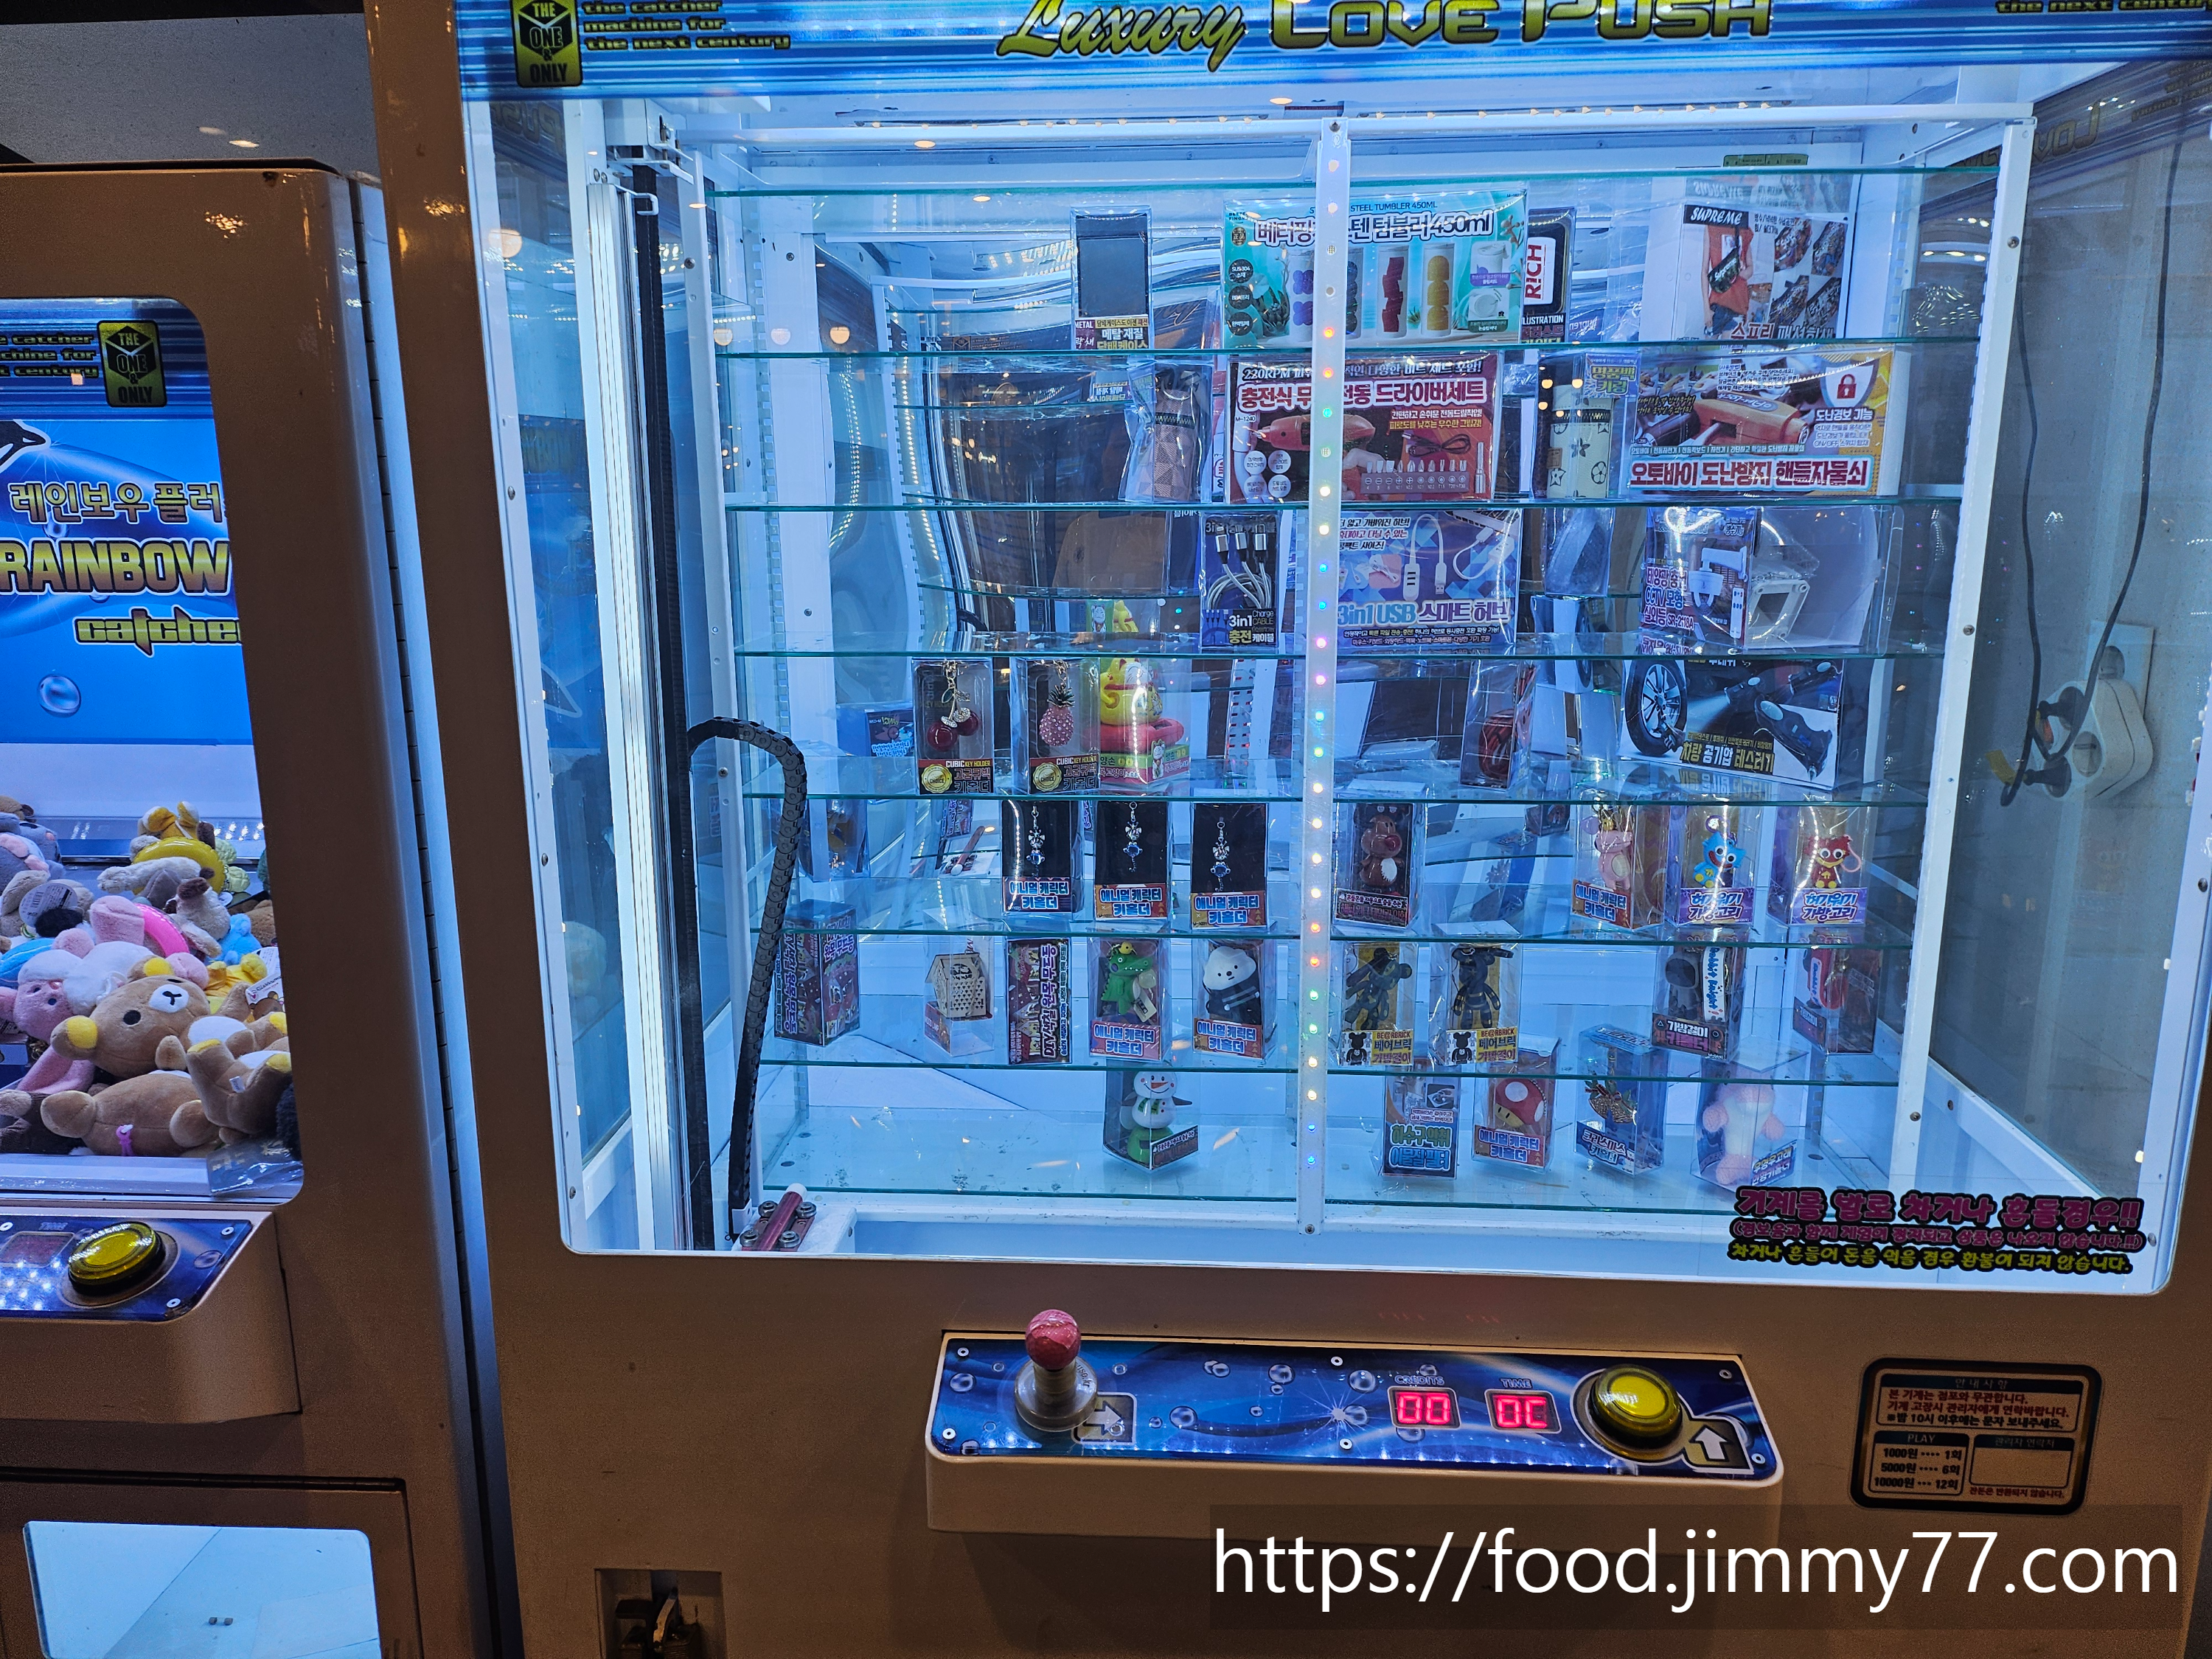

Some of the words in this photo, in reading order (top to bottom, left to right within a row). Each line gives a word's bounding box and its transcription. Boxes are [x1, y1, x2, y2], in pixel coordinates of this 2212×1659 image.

[533, 1, 556, 18] THE
[583, 17, 683, 33] machine
[686, 15, 726, 31] for
[529, 27, 563, 49] ONE
[585, 36, 628, 50] the
[632, 35, 692, 49] next
[695, 34, 790, 50] century
[997, 0, 1247, 72] Luxury
[1270, 0, 1499, 49] LOVE
[543, 47, 552, 60] &
[530, 63, 567, 83] ONLY
[1374, 203, 1410, 211] TUMBLER
[1691, 208, 1742, 224] SUPREME
[1258, 220, 1316, 244] 베터핑
[1525, 244, 1543, 299] RICH
[1074, 321, 1093, 329] METAL
[12, 333, 94, 345] catcher
[118, 333, 140, 346] THE
[0, 348, 58, 361] chine
[60, 349, 96, 361] for
[116, 354, 147, 373] ONE
[15, 366, 99, 378] century
[129, 373, 139, 384] &
[1591, 365, 1636, 380] 명품백
[117, 386, 153, 404] ONLY
[1596, 380, 1627, 394] 키링
[1242, 386, 1292, 408] 충전식
[1815, 408, 1851, 421] 도난경보
[1854, 408, 1873, 420] 기능
[1630, 462, 1698, 487] 오토바이
[1702, 461, 1772, 487] 도난방지
[1775, 460, 1868, 487] 핸들자물쇠
[10, 483, 150, 524] 레인보우
[1384, 529, 1391, 538] 수
[1392, 529, 1408, 538] 있는
[1360, 541, 1385, 550] 사이즈!
[0, 540, 229, 594] RAINBOW
[1647, 567, 1669, 587] 태양광
[1645, 585, 1666, 604] CCTV
[1666, 589, 1684, 609] 모형
[1229, 615, 1252, 627] 3in1
[1253, 610, 1273, 618] Charge
[1338, 603, 1373, 625] 3in1
[1377, 603, 1416, 624] USB
[1419, 602, 1471, 623] 스마트
[1474, 601, 1509, 622] 허브
[74, 607, 242, 656] catche
[1229, 630, 1252, 644] 충전
[1252, 633, 1274, 643] 케이블
[1100, 757, 1116, 766] 양손
[1680, 742, 1703, 762] 차량
[1703, 744, 1733, 767] 공기압
[1009, 881, 1038, 894] 애니멀
[1038, 880, 1068, 896] 캐릭터
[1100, 888, 1130, 903] 애니멀
[1131, 887, 1162, 902] 캐릭터
[1022, 895, 1058, 910] 키홀더
[1195, 895, 1225, 911] 애니멀
[1227, 894, 1259, 909] 캐릭터
[1575, 883, 1600, 903] 애니멀
[1600, 890, 1627, 910] 캐릭터
[1113, 902, 1150, 917] 키홀더
[1208, 909, 1248, 925] 키홀더
[1584, 900, 1615, 922] 키홀더
[1041, 944, 1057, 979] 무드등
[1093, 1025, 1123, 1040] 애니멀
[1124, 1027, 1155, 1044] 캐릭터
[1196, 1023, 1226, 1038] 애니멀
[1226, 1025, 1258, 1042] 캐릭터
[1377, 1031, 1411, 1040] BE@RBRICK
[1481, 1028, 1514, 1037] BE@RBRICK
[1667, 1020, 1708, 1038] 가방걸이
[1106, 1040, 1144, 1057] 키홀더
[1208, 1037, 1245, 1054] 키홀더
[1374, 1040, 1411, 1051] 베어브릭
[1479, 1037, 1516, 1049] 베어브릭
[1374, 1052, 1411, 1065] 가방걸이
[1478, 1049, 1516, 1062] 가방걸이
[1391, 1124, 1427, 1146] 하수구
[1478, 1128, 1507, 1146] 애니멀
[1508, 1133, 1540, 1152] 캐릭터
[1391, 1147, 1425, 1168] 이물질
[1489, 1144, 1528, 1163] 키홀더
[1738, 1189, 1825, 1221] 기계를
[1833, 1192, 1893, 1221] 발로
[1902, 1193, 1994, 1223] 차거나
[1805, 1223, 1838, 1240] 함께
[1840, 1225, 1888, 1242] 게임이
[1892, 1227, 1952, 1244] 정지되고
[1956, 1230, 2004, 1247] 상품은
[2007, 1231, 2056, 1248] 나오지
[1732, 1242, 1782, 1259] 차거나
[1787, 1245, 1838, 1262] 흔들어
[1843, 1247, 1877, 1264] 돈을
[1882, 1248, 1916, 1265] 먹을
[1923, 1251, 1955, 1266] 경우
[2017, 1253, 2051, 1269] 되지
[1394, 1375, 1445, 1386] CREDITS
[1500, 1378, 1533, 1388] TIME
[1888, 1389, 1900, 1399] 본
[1903, 1389, 1934, 1401] 기계는
[1938, 1391, 1970, 1402] 점포와
[1398, 1393, 1450, 1425] 00
[1888, 1401, 1908, 1412] 기계
[1911, 1402, 1943, 1413] 고장시
[1946, 1402, 2000, 1415] 관리자에게
[1911, 1413, 1935, 1425] 10시
[1938, 1413, 1980, 1426] 이후에는
[1982, 1415, 2004, 1427] 문자
[1907, 1433, 1935, 1444] PLAY
[1883, 1447, 1918, 1459] 1000원
[1944, 1450, 1962, 1461] 1회
[1881, 1462, 1916, 1474] 5000원
[1941, 1464, 1961, 1476] 6회
[1874, 1476, 1914, 1489] 10000원
[1935, 1478, 1958, 1490] 12회
